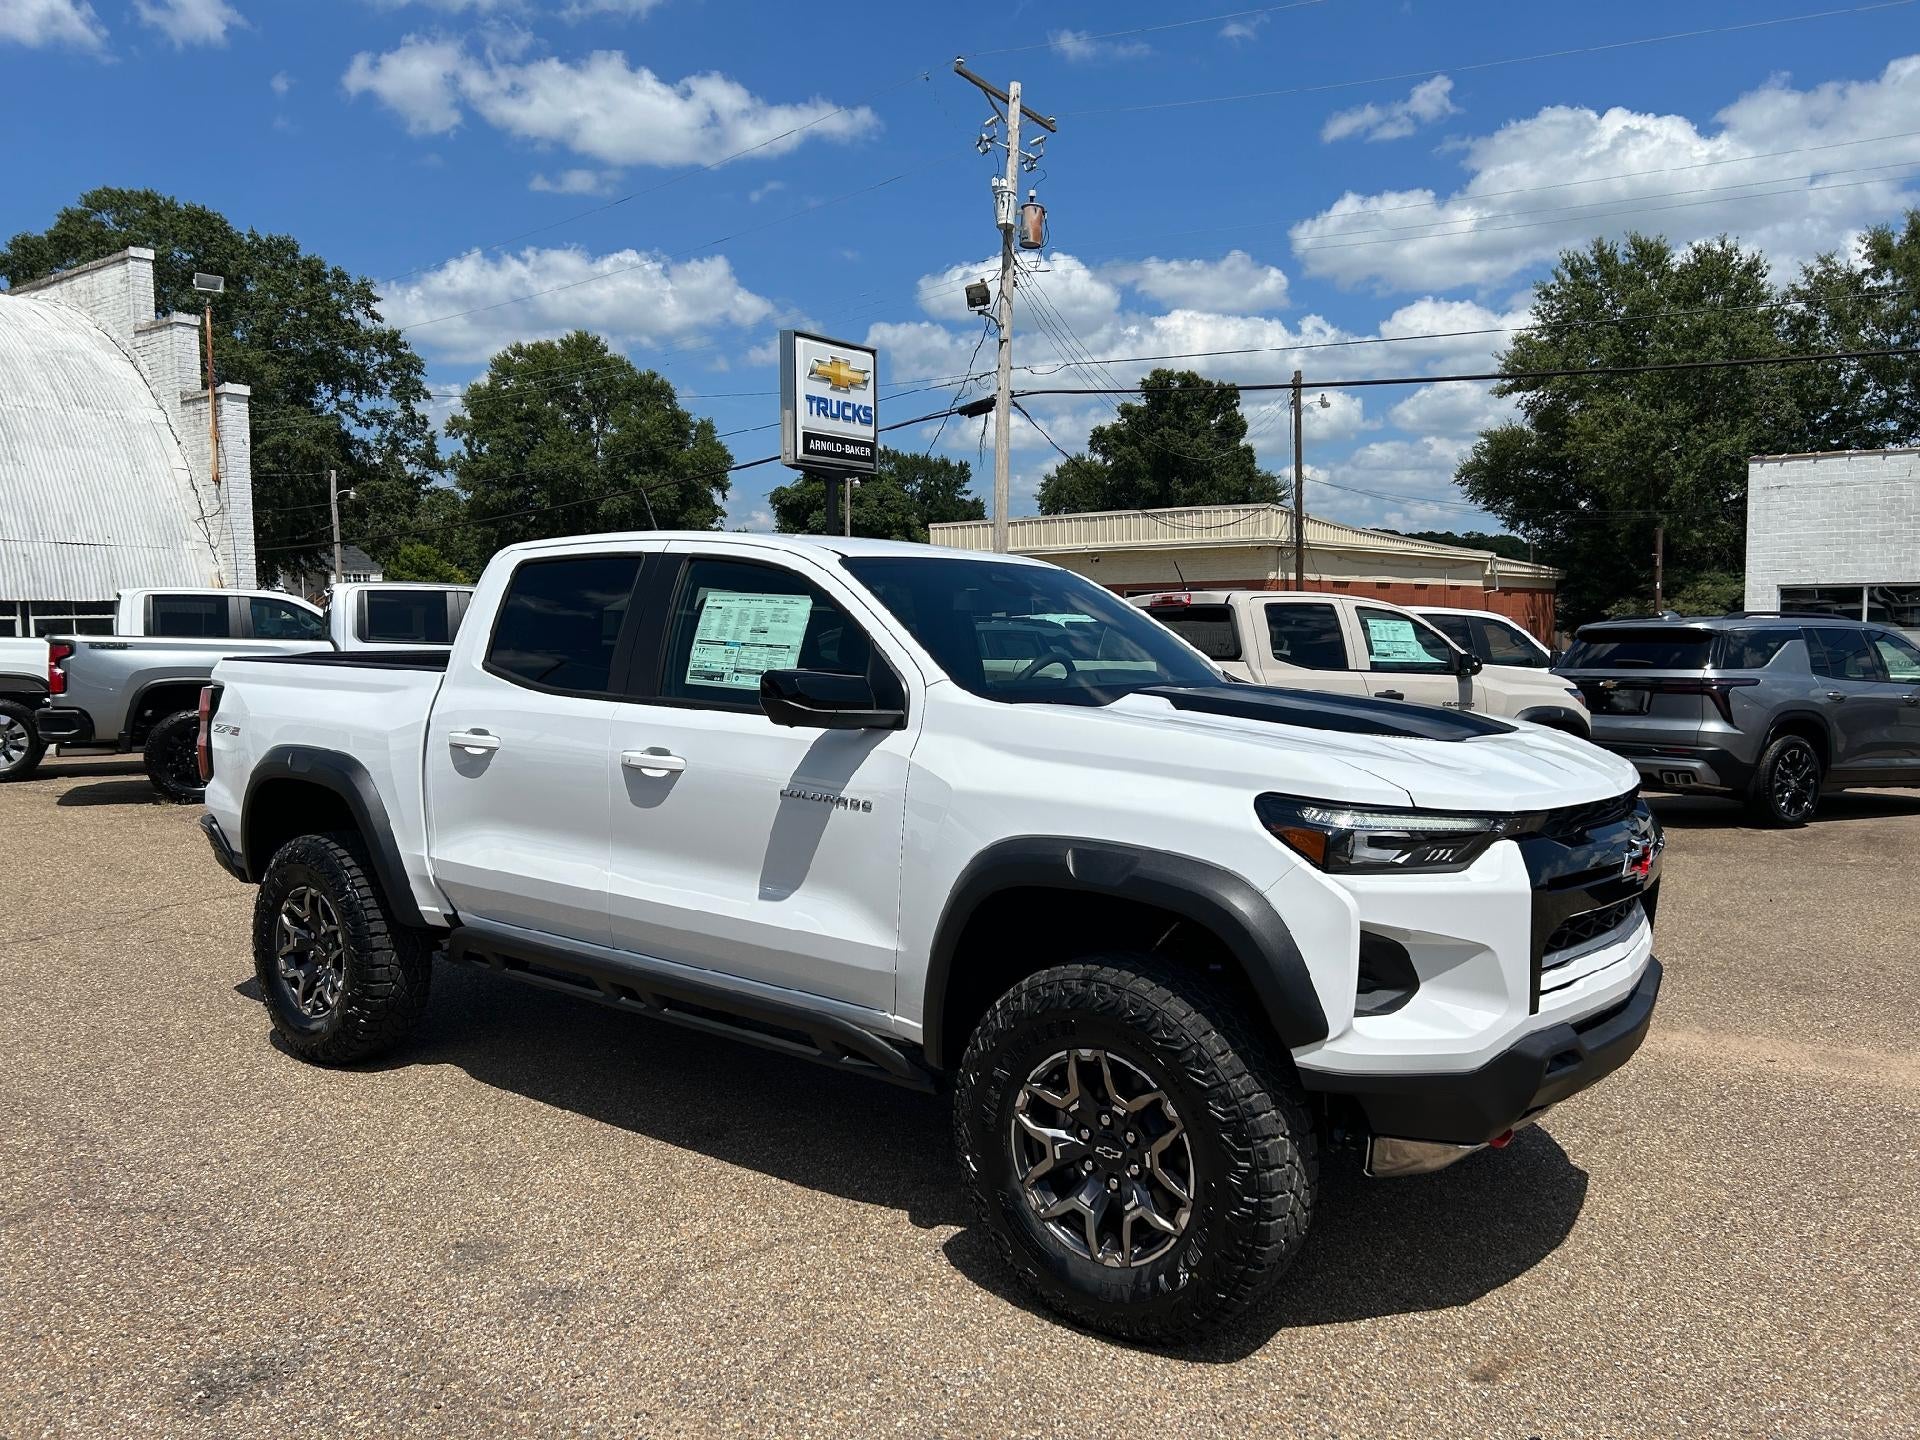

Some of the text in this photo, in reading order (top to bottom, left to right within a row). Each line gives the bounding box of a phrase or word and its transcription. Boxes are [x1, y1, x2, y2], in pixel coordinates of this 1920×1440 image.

[805, 394, 873, 426] TRUCKS
[809, 439, 871, 457] ARNOLD-BAKER
[780, 789, 873, 813] COLORADO
